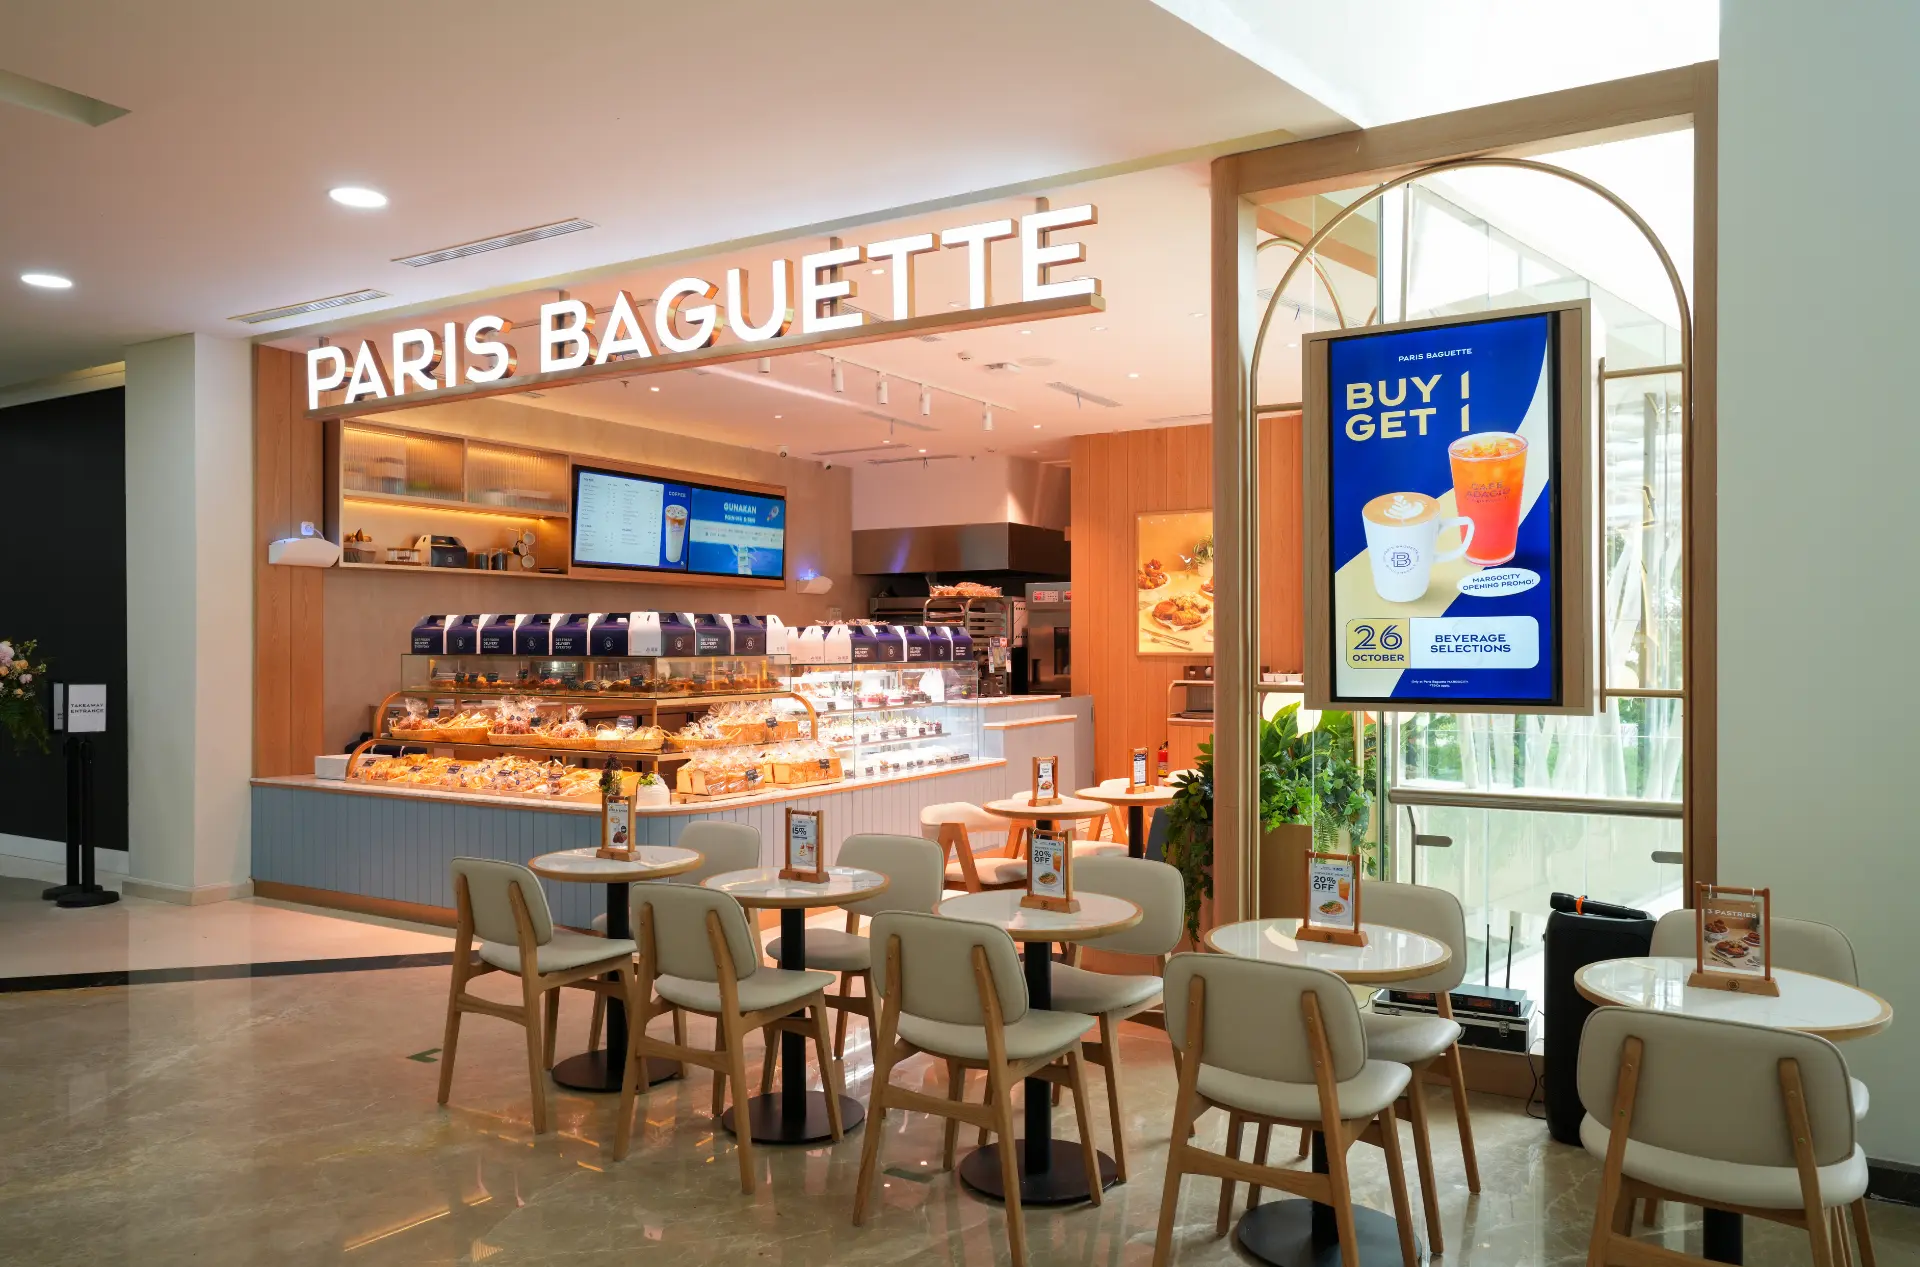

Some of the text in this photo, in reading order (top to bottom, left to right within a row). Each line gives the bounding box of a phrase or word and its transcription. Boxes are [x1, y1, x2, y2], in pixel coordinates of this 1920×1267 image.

[306, 203, 1101, 409] PARIS BAGUETTE
[1398, 347, 1473, 362] PARIS BAGUETTE
[1346, 373, 1442, 411] BUY
[1345, 407, 1437, 442] GET
[723, 502, 757, 515] GUNAKAN
[1472, 573, 1521, 583] MARGOCITY
[1462, 579, 1535, 591] OPENING PROMO!
[1353, 624, 1403, 651] 26
[1435, 633, 1507, 643] BEVERAGE
[1430, 644, 1512, 653] SELECTIONS
[1352, 654, 1405, 662] OCTOBER
[1313, 875, 1336, 884] 20%
[1714, 909, 1757, 918] PASTRIES
